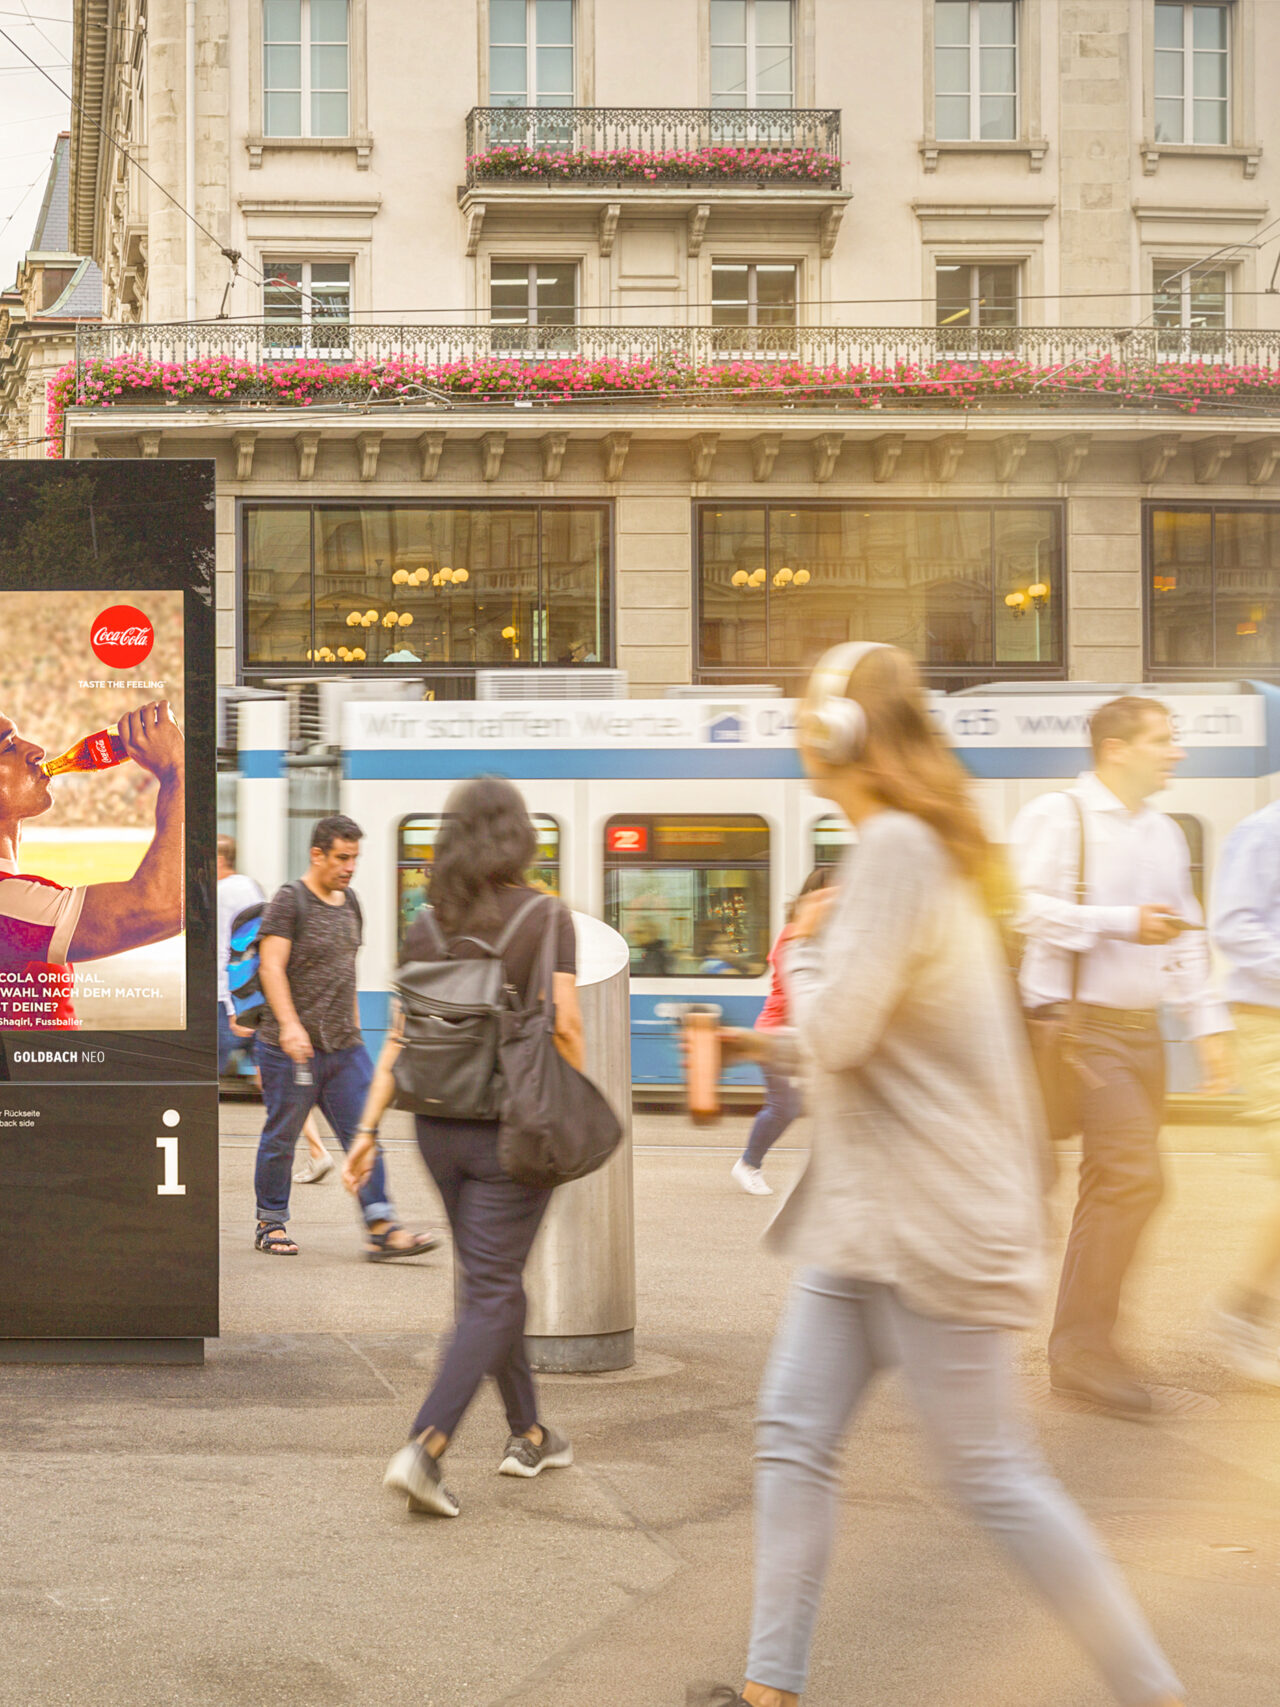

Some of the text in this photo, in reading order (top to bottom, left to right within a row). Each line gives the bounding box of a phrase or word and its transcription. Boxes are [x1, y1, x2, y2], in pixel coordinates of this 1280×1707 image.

[93, 626, 151, 646] Coca-Cola
[78, 680, 106, 689] TASTE
[107, 680, 125, 689] THE
[424, 710, 570, 739] schaffen
[613, 830, 640, 848] 2
[37, 972, 105, 983] ORIGINAL.
[0, 987, 39, 998] WAHL
[42, 987, 79, 998] NACH
[83, 987, 111, 998] DEM
[115, 987, 164, 998] MATCH.
[12, 1002, 58, 1012] DEINE?
[35, 1017, 83, 1026] Fussballer
[13, 1051, 105, 1063] GOLDBACH NEO
[3, 1109, 41, 1118] Rückseite
[19, 1119, 35, 1128] side
